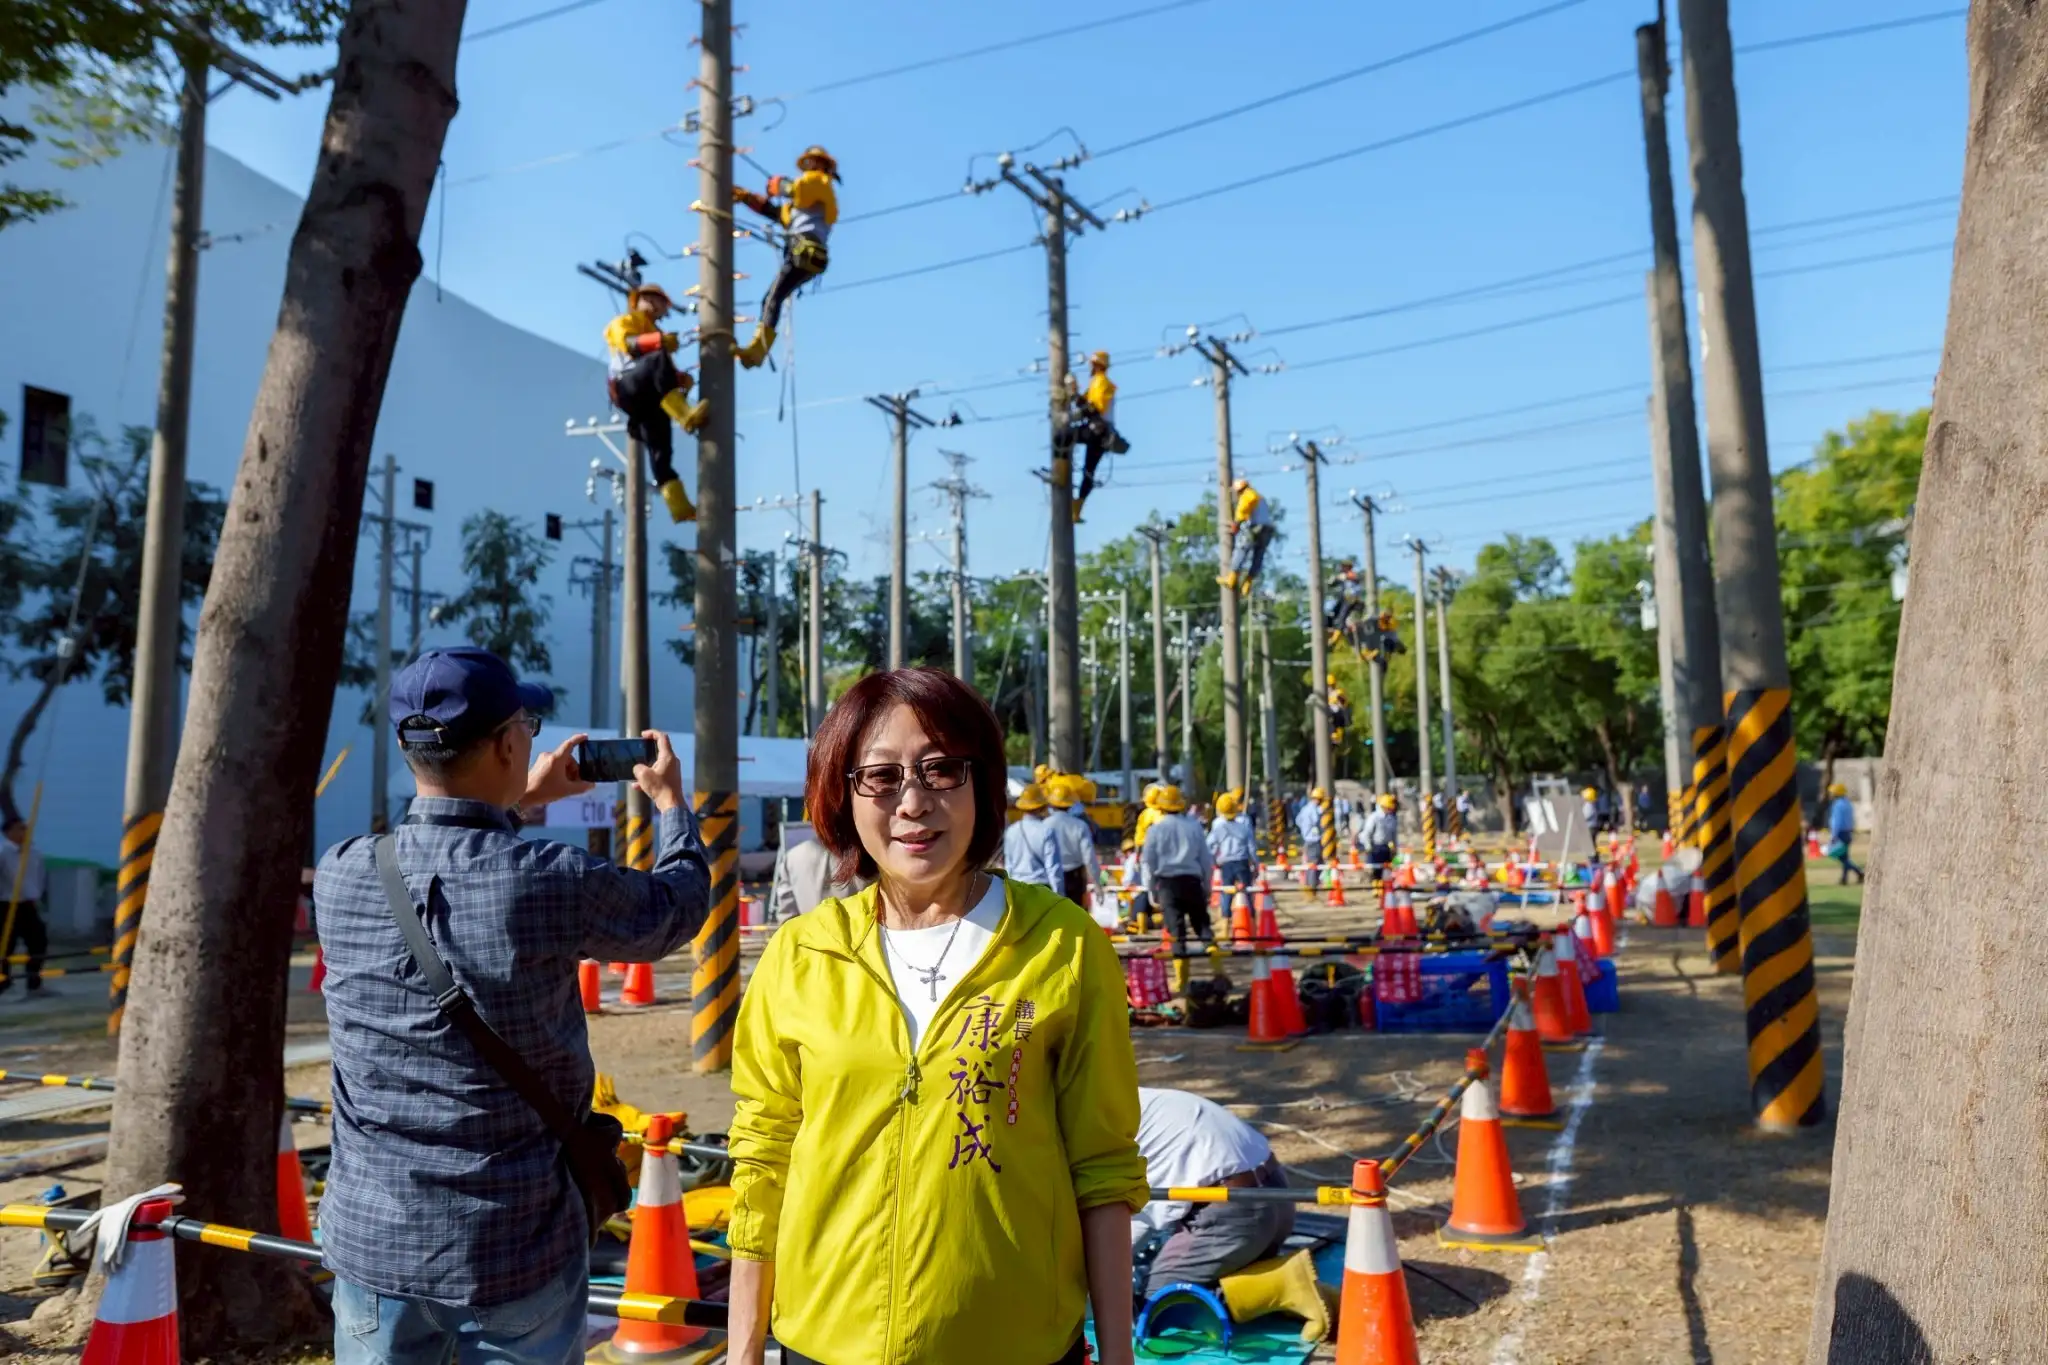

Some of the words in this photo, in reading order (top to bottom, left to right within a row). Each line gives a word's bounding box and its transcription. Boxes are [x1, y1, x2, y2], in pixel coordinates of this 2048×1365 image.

[1013, 999, 1035, 1042] 議長
[946, 995, 1005, 1173] 康裕成
